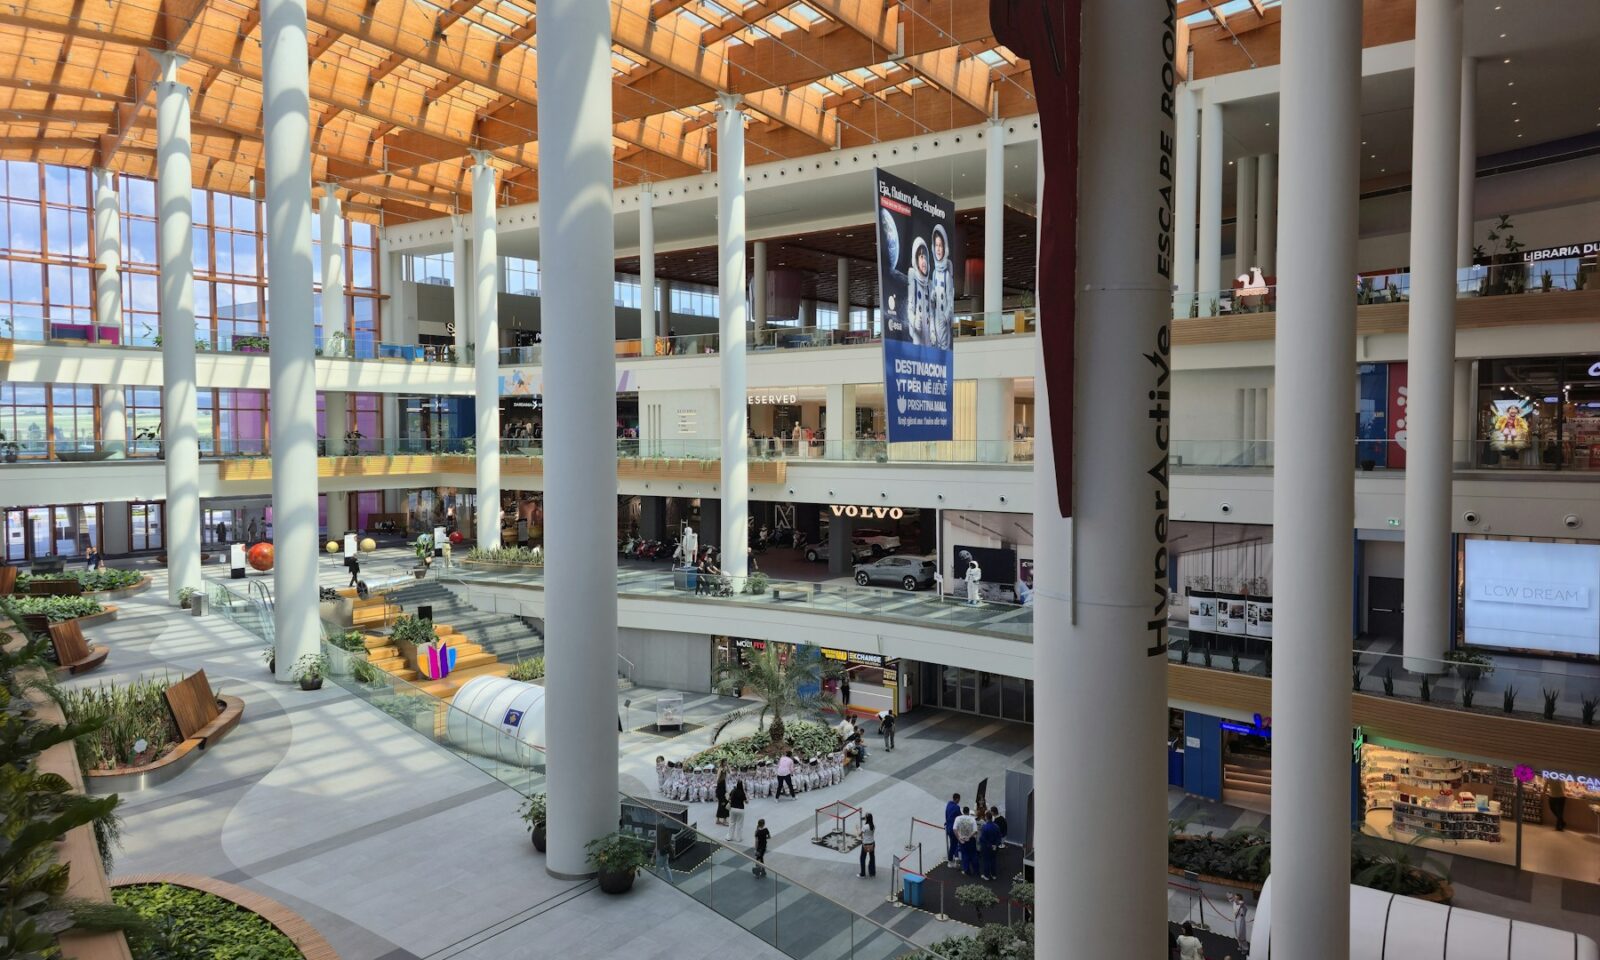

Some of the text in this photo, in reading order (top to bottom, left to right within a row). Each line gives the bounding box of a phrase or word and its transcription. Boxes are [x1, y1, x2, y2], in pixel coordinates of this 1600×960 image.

[912, 195, 922, 209] dhe
[1157, 130, 1173, 280] ESCAPE
[1523, 245, 1580, 262] LIBRARIA
[895, 359, 947, 378] DESTINACIONI
[829, 504, 903, 520] VOLVO
[1484, 585, 1579, 601] LCW DREAM
[1542, 770, 1575, 782] ROSA
